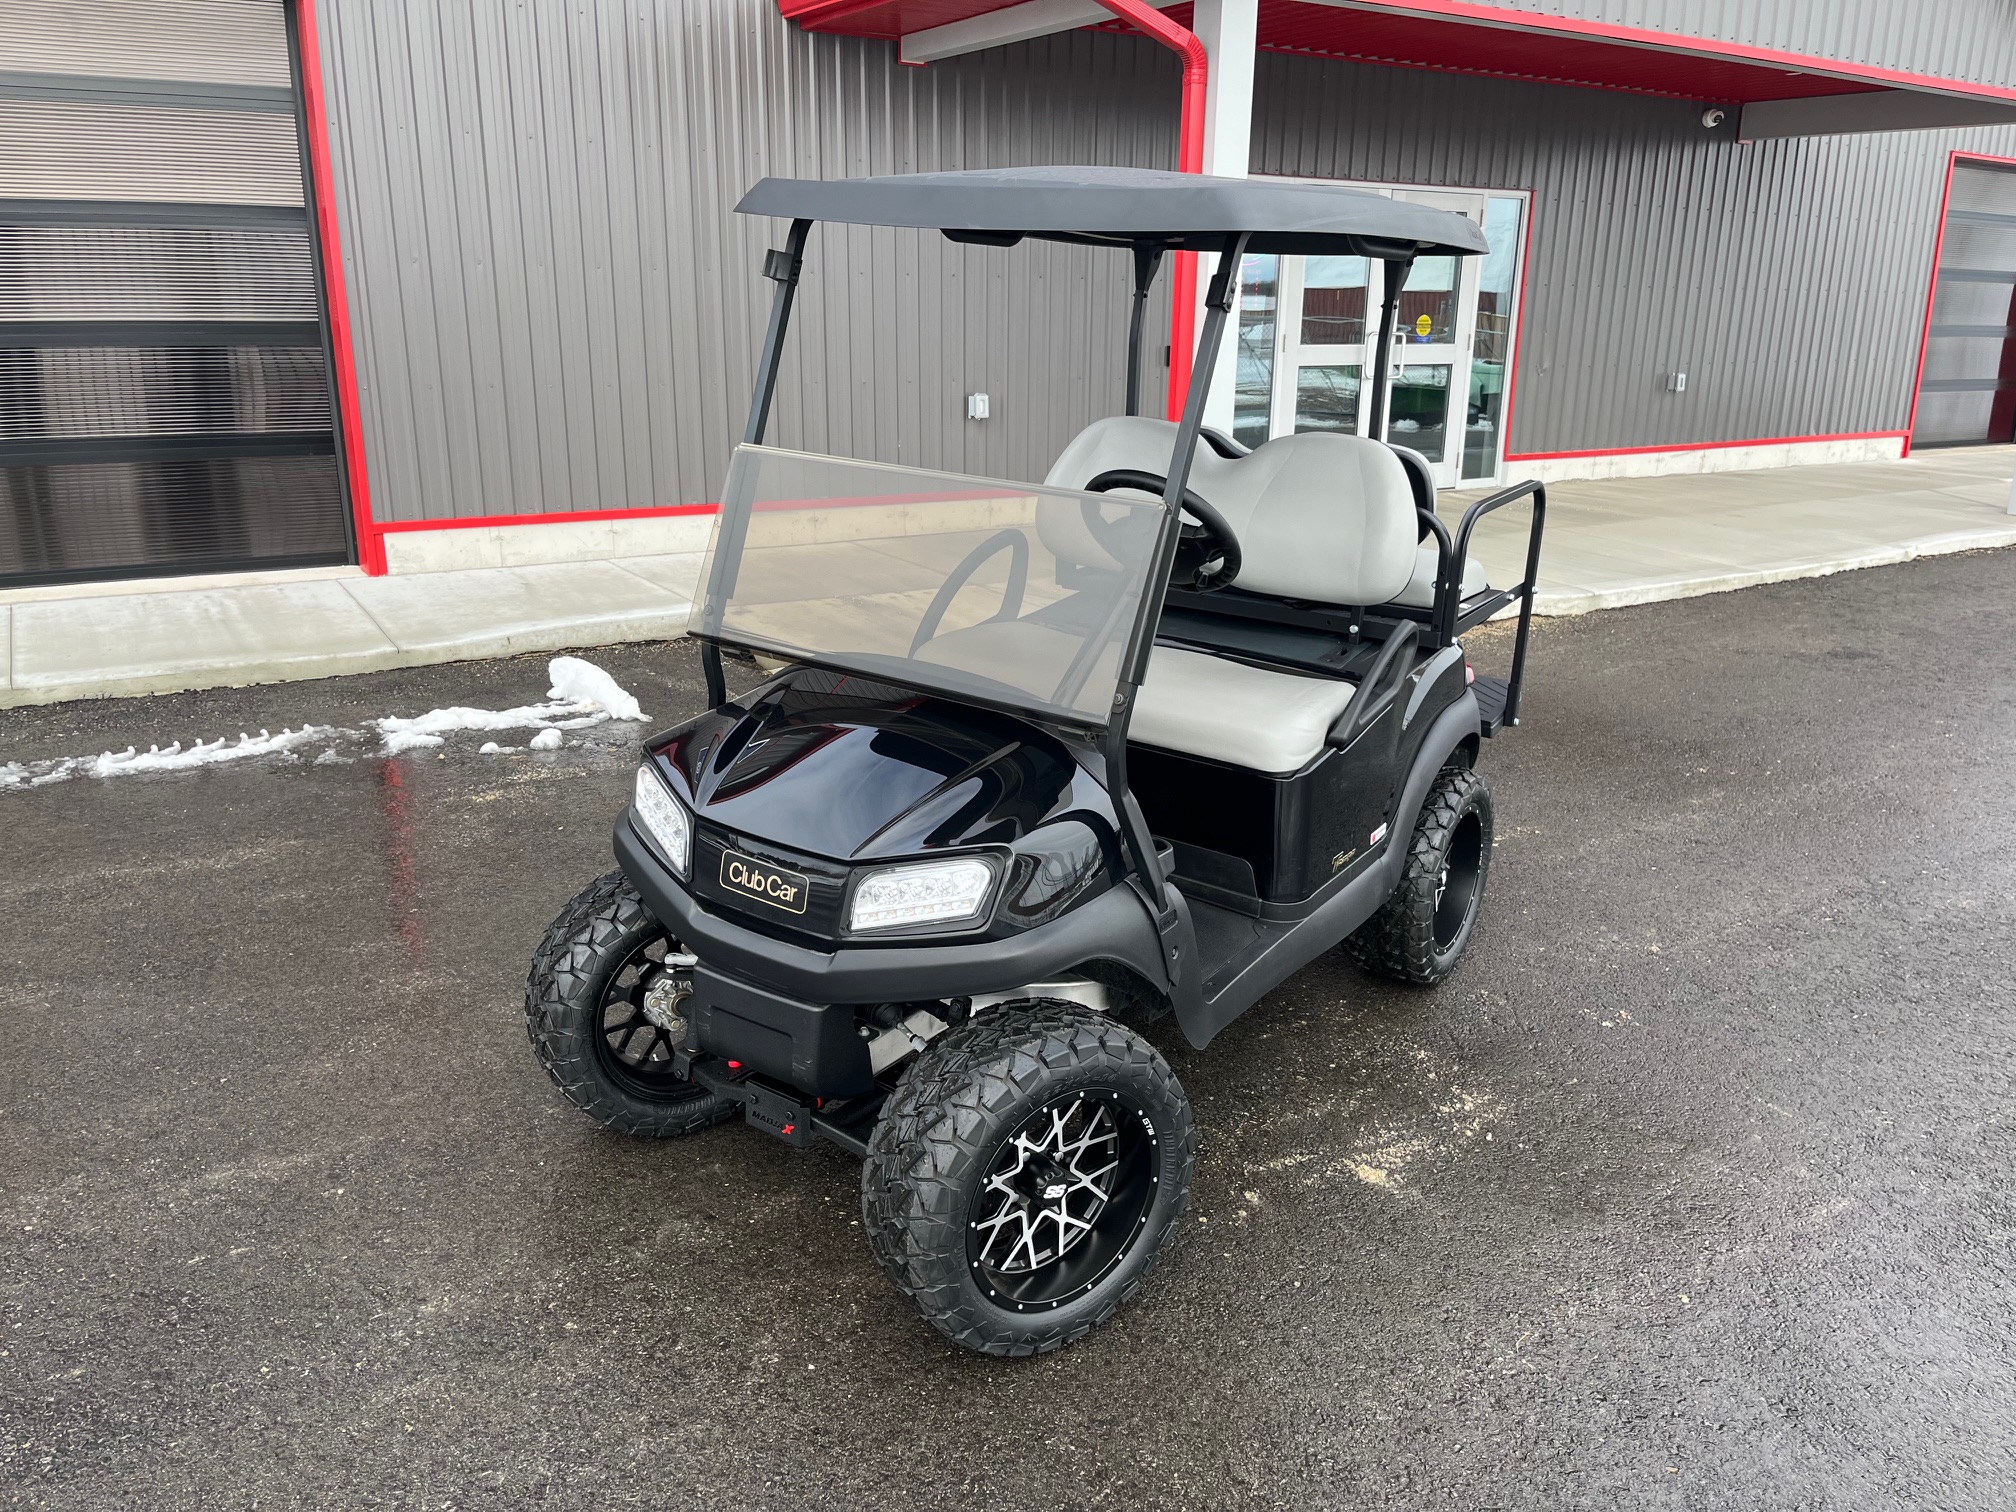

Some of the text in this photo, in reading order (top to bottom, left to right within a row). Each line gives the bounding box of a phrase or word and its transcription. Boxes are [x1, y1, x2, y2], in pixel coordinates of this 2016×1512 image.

[729, 861, 798, 902] Club Car
[1142, 1117, 1155, 1136] GTW
